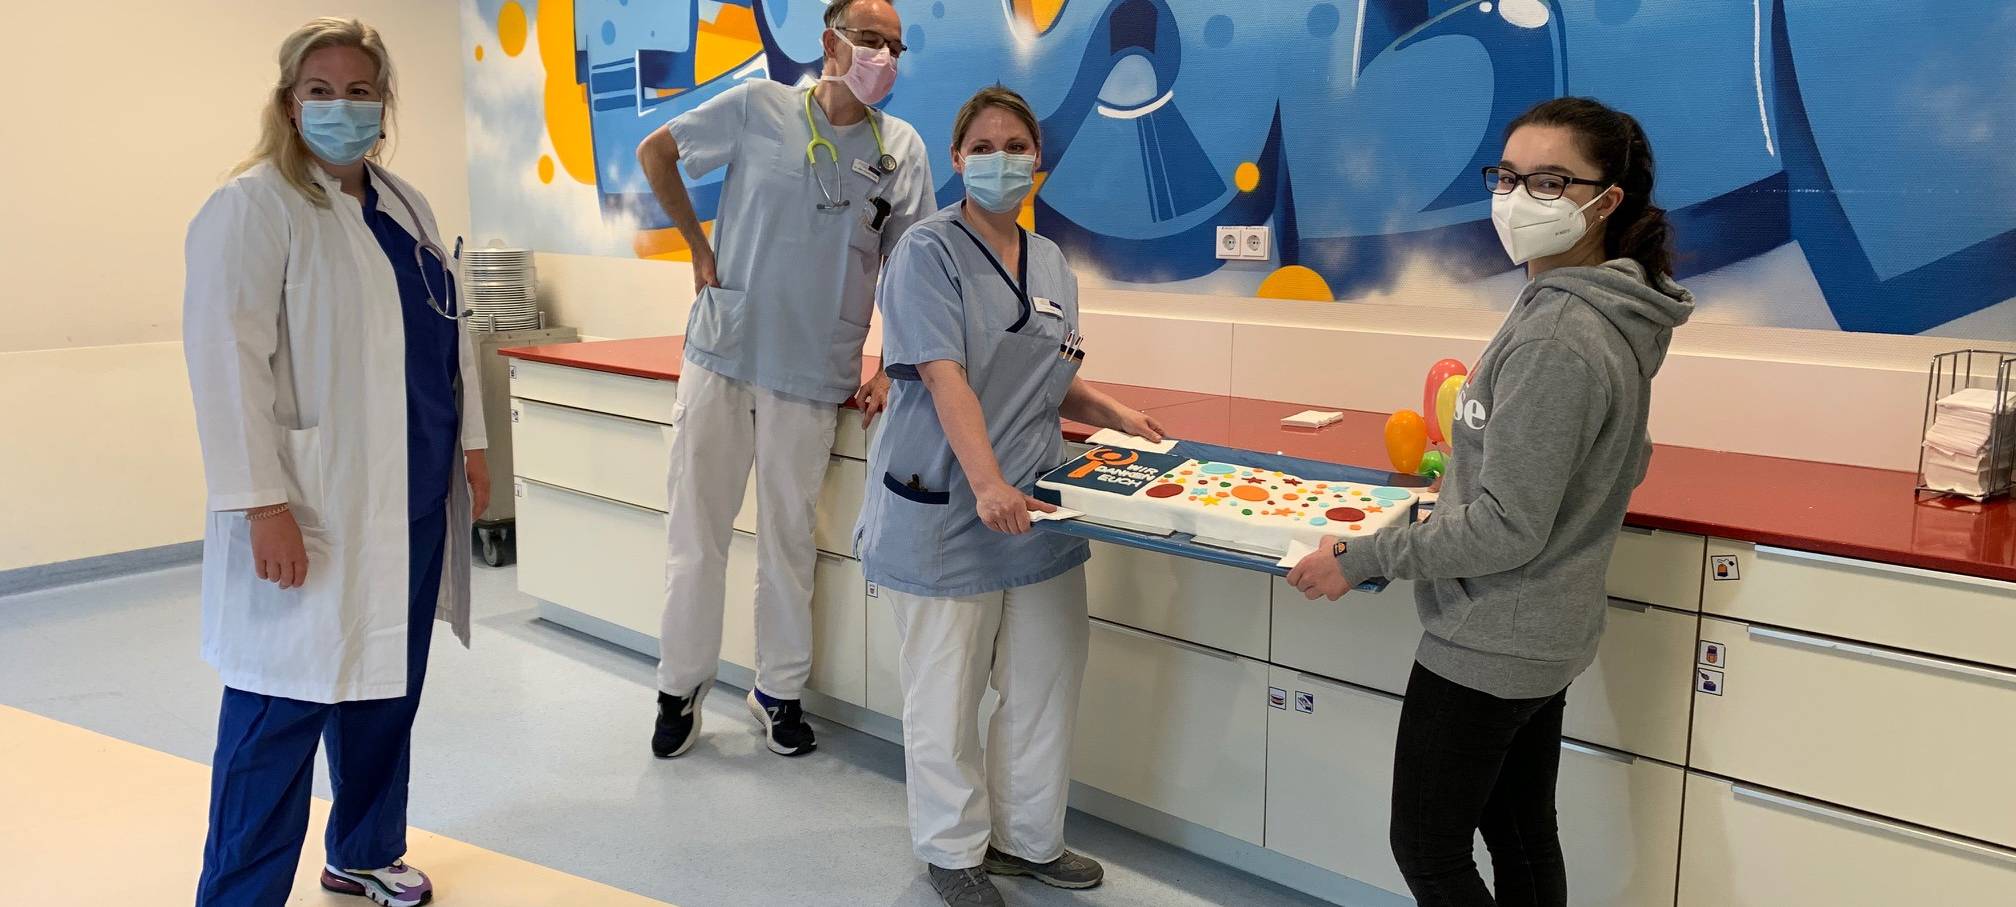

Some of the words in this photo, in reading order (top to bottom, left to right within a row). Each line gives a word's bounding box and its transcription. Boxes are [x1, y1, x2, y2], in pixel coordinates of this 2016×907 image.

[1095, 466, 1156, 481] DANKEN
[1126, 464, 1159, 475] WIR
[1097, 474, 1143, 487] EUCH
